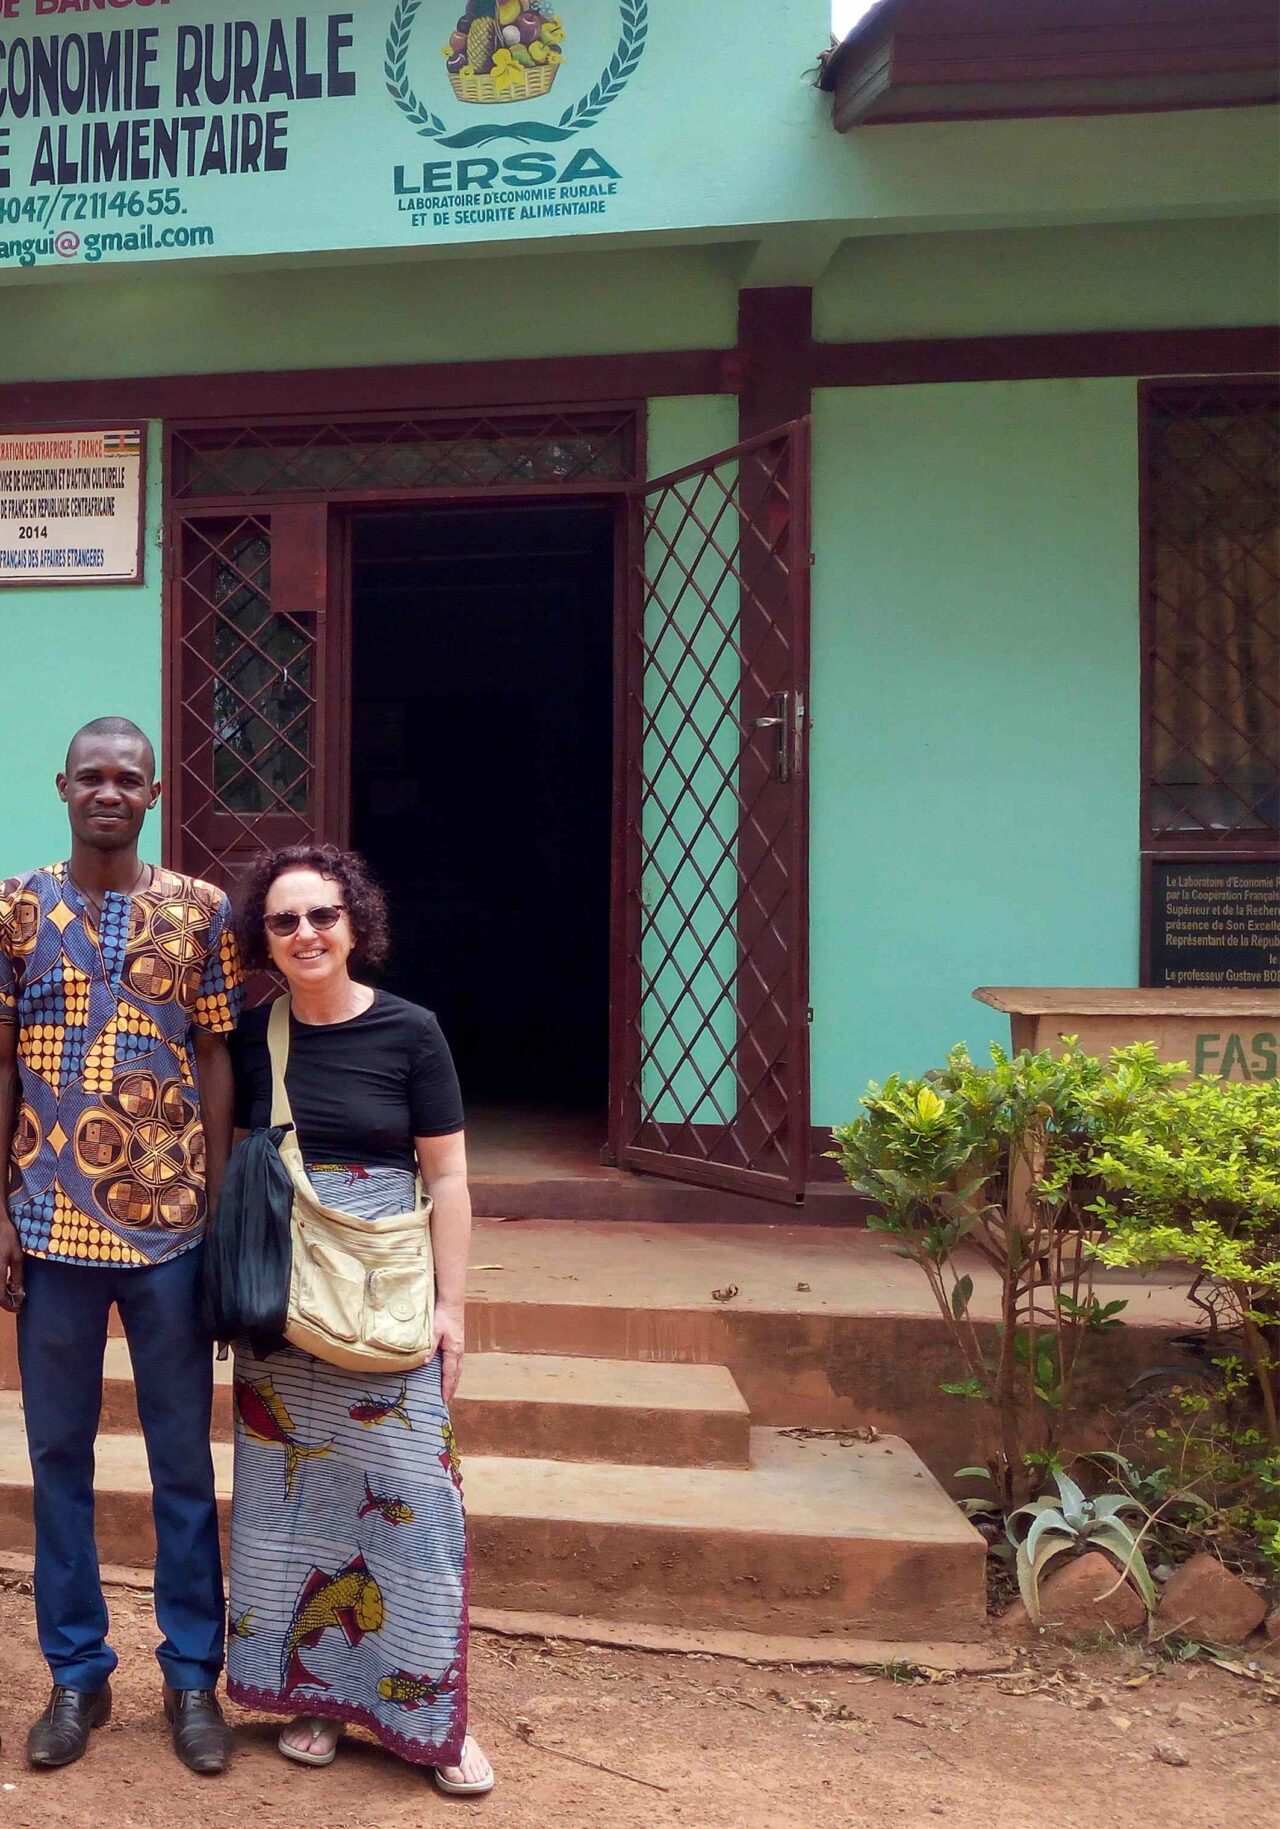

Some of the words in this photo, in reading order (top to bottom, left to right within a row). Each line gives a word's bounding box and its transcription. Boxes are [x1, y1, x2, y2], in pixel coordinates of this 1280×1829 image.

[175, 14, 357, 107] RURALE
[30, 111, 288, 187] ALIMENTAIRE
[393, 147, 623, 195] LERSA
[398, 193, 481, 211] LABORATOIRE
[483, 187, 556, 205] D'ECONOMIE
[559, 182, 618, 199] RURALE
[411, 213, 428, 227] ET
[433, 211, 450, 225] DE
[454, 207, 516, 224] SECURITE
[520, 200, 606, 220] ALIMENTAIRE
[25, 440, 72, 460] CENTRAFRIQUE
[77, 439, 103, 459] FRANCE
[13, 469, 20, 491] DE
[21, 468, 58, 491] COOPERATION
[59, 467, 65, 490] ET
[92, 467, 125, 488] CULTURELLE
[1, 499, 7, 519] DE
[8, 499, 28, 519] FRANCE
[29, 499, 37, 518] EN
[38, 498, 69, 518] REPUBLIQUE
[71, 497, 115, 517] CENTRAFRICAINE
[18, 526, 48, 539] 2014
[28, 549, 39, 568] DES
[40, 549, 65, 568] AFFAIRES
[67, 548, 104, 568] ETRANGERES
[1166, 875, 1176, 887] Le
[1178, 876, 1223, 888] Laboratoire
[1166, 891, 1179, 901] par
[1182, 890, 1189, 900] la
[1166, 904, 1210, 917] Supérieur
[1212, 905, 1221, 915] et
[1223, 904, 1234, 915] de
[1236, 904, 1244, 915] la
[1165, 919, 1209, 932] présence
[1212, 920, 1223, 931] de
[1226, 920, 1245, 931] Son
[1165, 934, 1225, 949] Représentant
[1227, 935, 1238, 946] de
[1241, 935, 1249, 946] la
[1165, 968, 1176, 981] Le
[1178, 968, 1224, 983] professeur
[1226, 969, 1261, 981] Gustave
